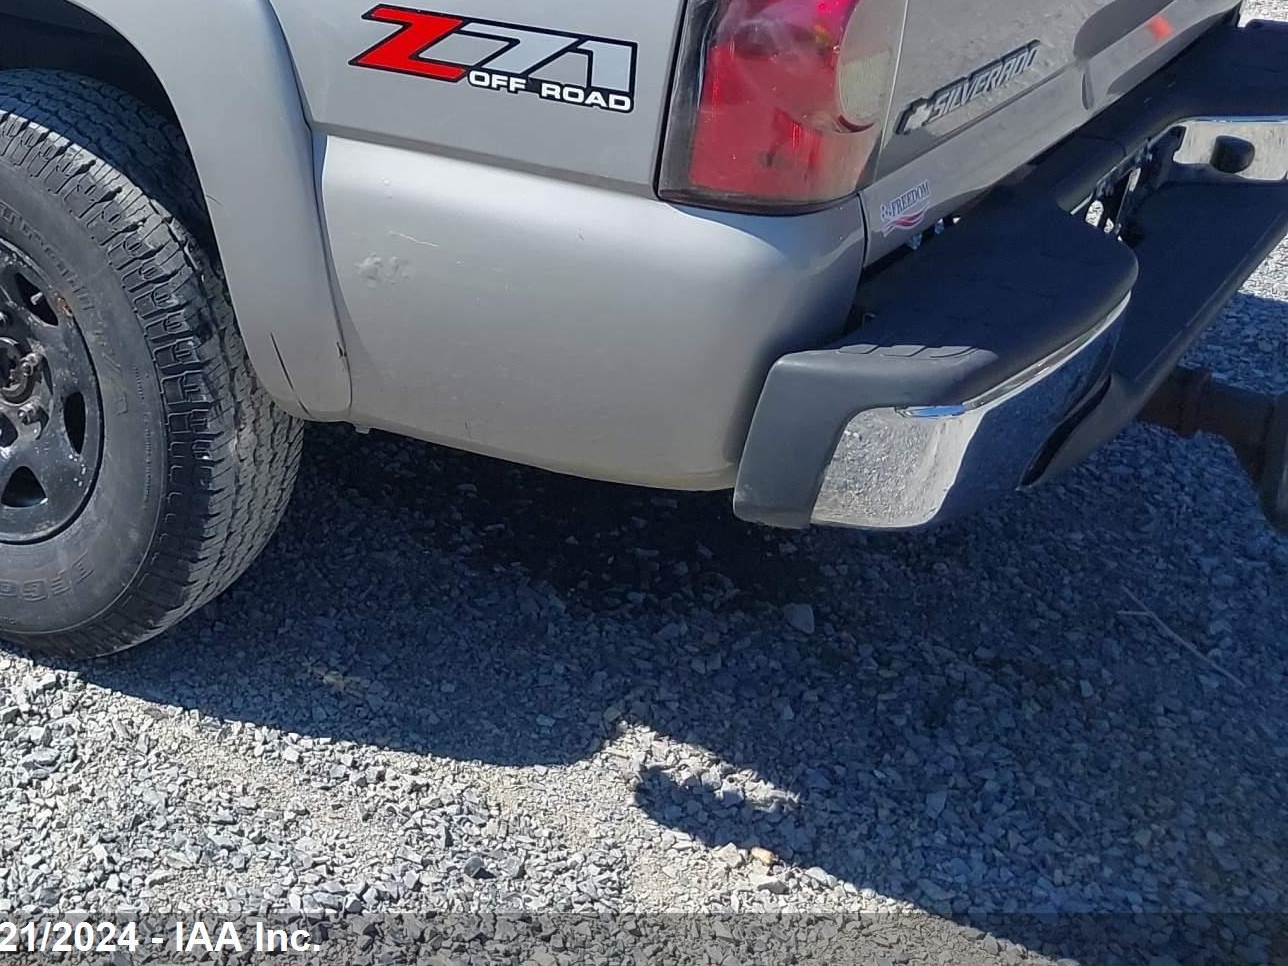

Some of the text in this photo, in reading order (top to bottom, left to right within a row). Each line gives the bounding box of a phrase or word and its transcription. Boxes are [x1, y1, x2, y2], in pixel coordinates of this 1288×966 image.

[349, 3, 638, 95] Z71
[468, 70, 632, 111] OFF ROAD
[927, 43, 1041, 125] SILVERADO
[891, 179, 930, 217] FREEDOM
